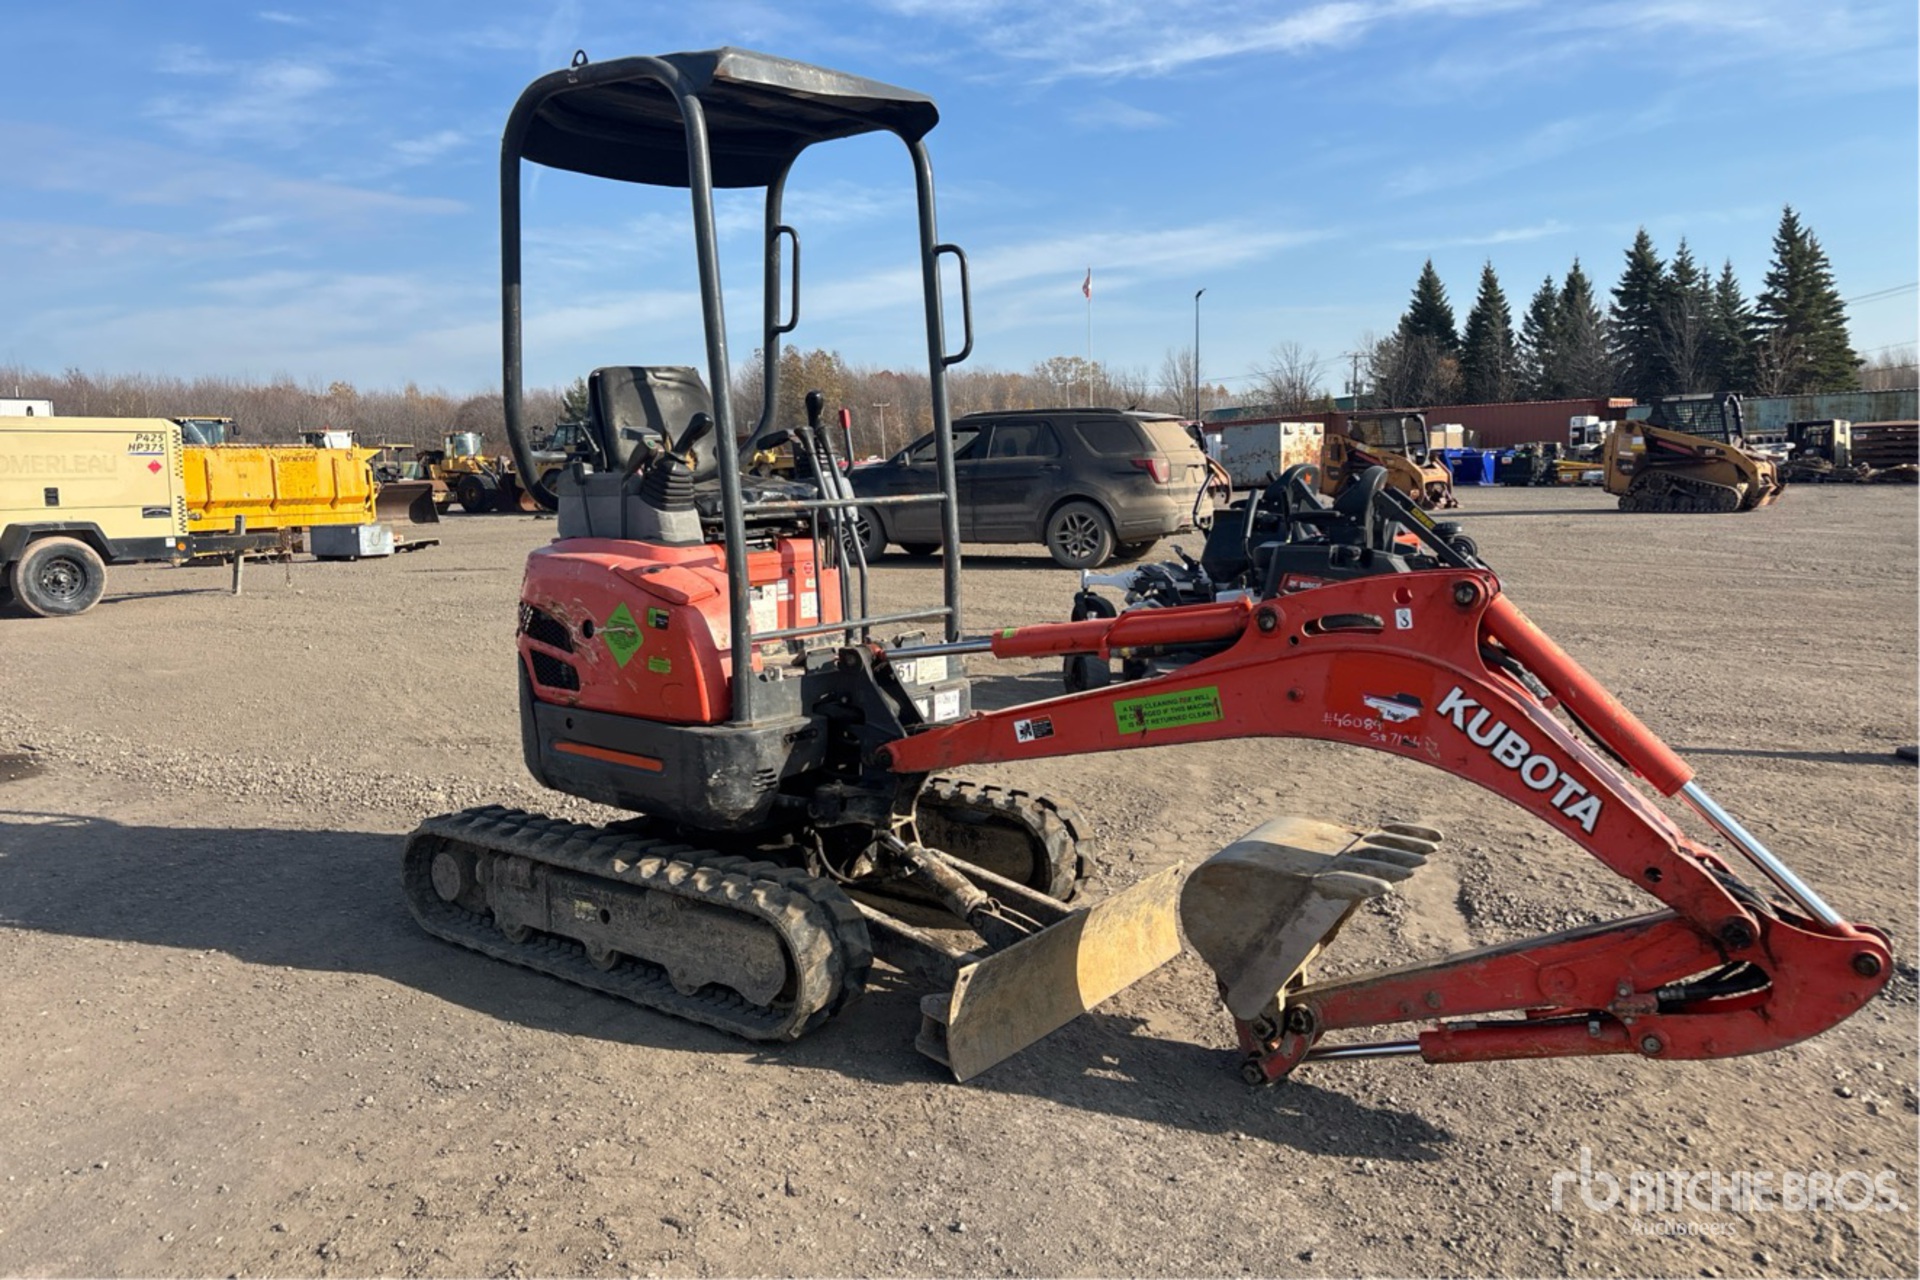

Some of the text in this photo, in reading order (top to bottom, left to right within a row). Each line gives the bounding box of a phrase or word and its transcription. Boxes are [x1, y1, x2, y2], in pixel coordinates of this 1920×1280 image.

[135, 433, 164, 442] P425
[127, 443, 165, 452] HP375
[1144, 698, 1178, 708] CLEANING
[1170, 705, 1186, 713] THIS
[1151, 714, 1187, 724] RETURNED
[1436, 686, 1603, 834] KUBOTA
